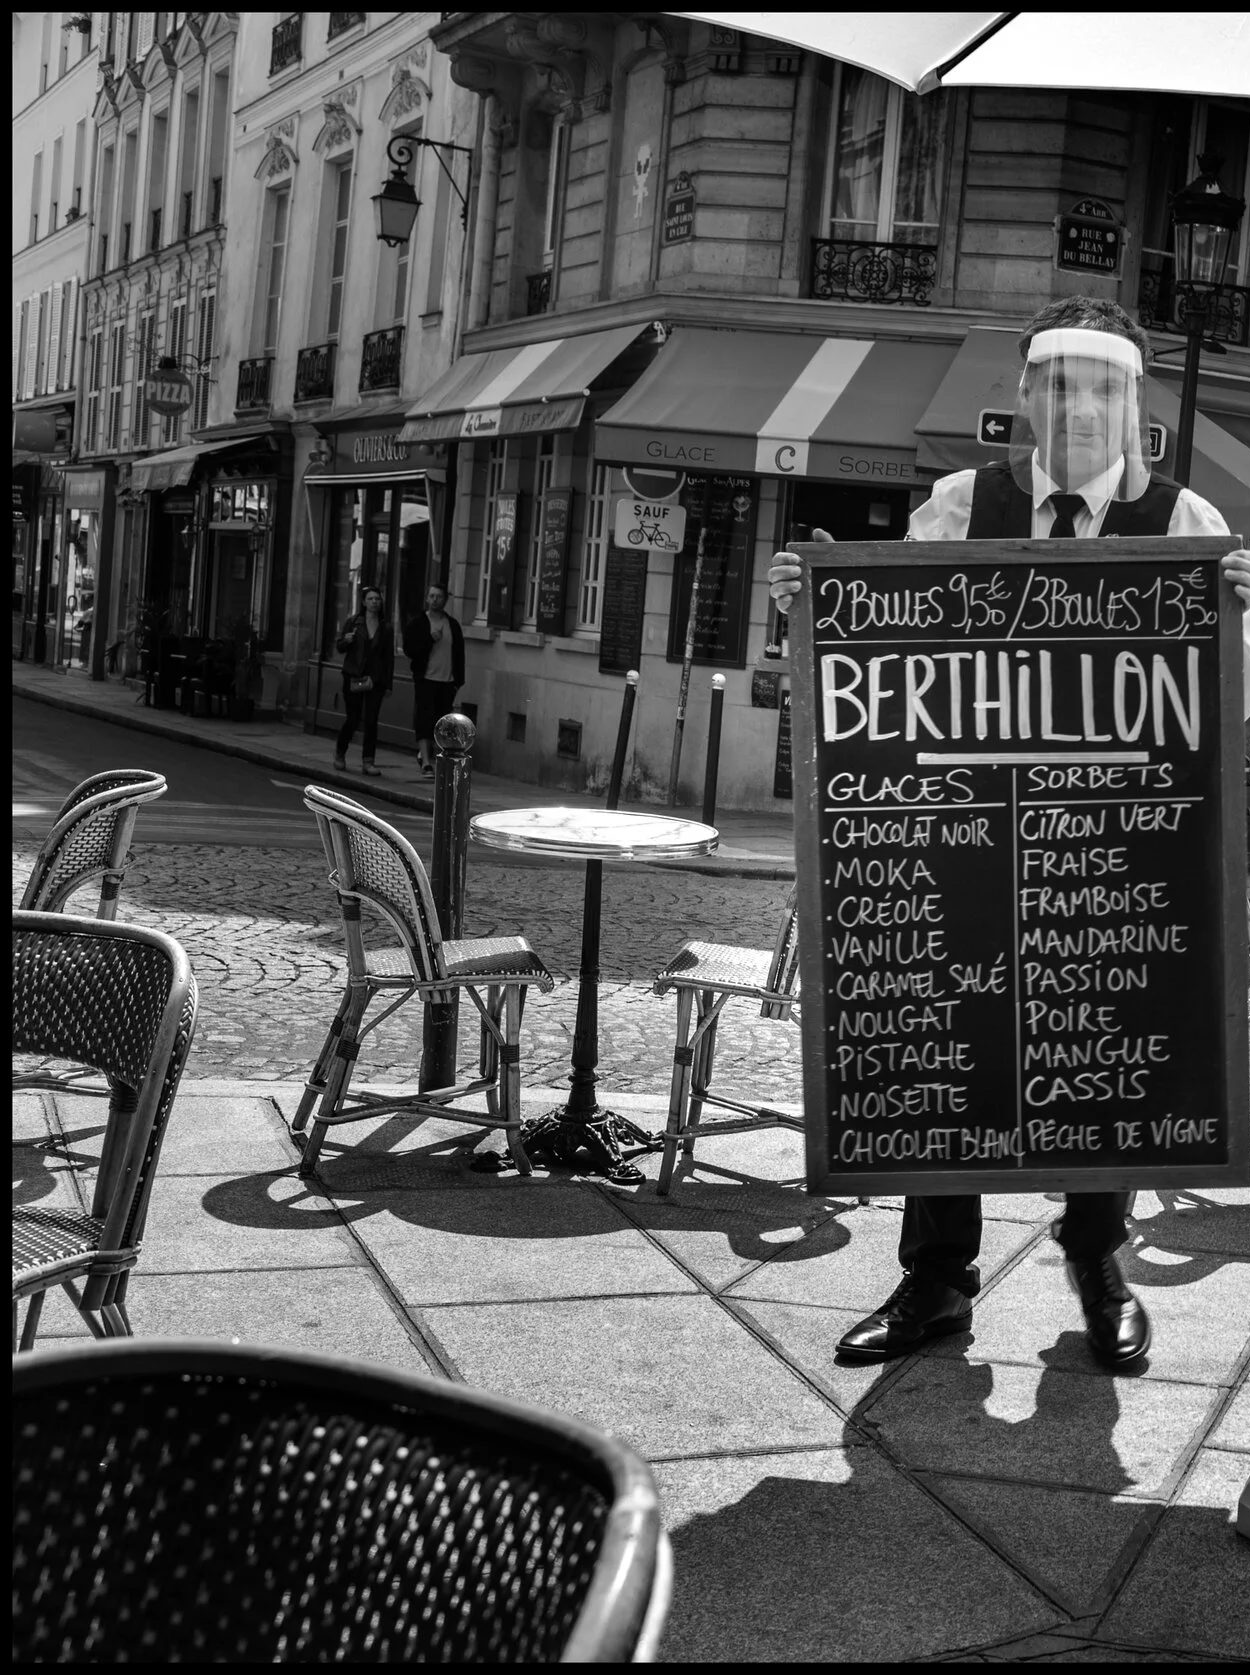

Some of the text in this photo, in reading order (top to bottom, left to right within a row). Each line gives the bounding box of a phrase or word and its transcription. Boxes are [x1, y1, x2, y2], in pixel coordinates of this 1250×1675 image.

[1078, 240, 1104, 253] JEAN
[1081, 228, 1102, 241] RUE
[1063, 250, 1117, 268] DU BELLAY
[145, 381, 191, 404] PIZZA
[646, 440, 715, 462] GLACE
[774, 445, 796, 473] C
[634, 505, 671, 519] SAUF
[820, 645, 1200, 752] BERTHILLON
[827, 768, 975, 803] GLACES
[1026, 762, 1174, 793] SORBETS
[832, 813, 995, 849] CHOCOLAT NOIR
[1019, 803, 1193, 842] CITRON VERT
[833, 858, 938, 889] MOKA
[1021, 846, 1131, 881] FRAISE
[836, 892, 946, 928] CRÉOLE
[1018, 882, 1172, 921] FRAMBOISE
[832, 930, 949, 967] VANILLE
[1018, 924, 1190, 959] MANDARINE
[835, 952, 1008, 1002] CARAMEL SALÉ
[1023, 959, 1149, 997] PASSION
[837, 999, 962, 1041] NOUGAT
[1023, 998, 1123, 1035] POIRE
[836, 1040, 977, 1082] PISTACHE
[1023, 1034, 1172, 1072] MANGUE
[839, 1082, 970, 1121] NOISETTE
[1024, 1068, 1153, 1107] CASSIS
[838, 1126, 1025, 1165] CHOCOLAT BLANC
[1026, 1113, 1219, 1153] PÊCHE DE VIGNE
